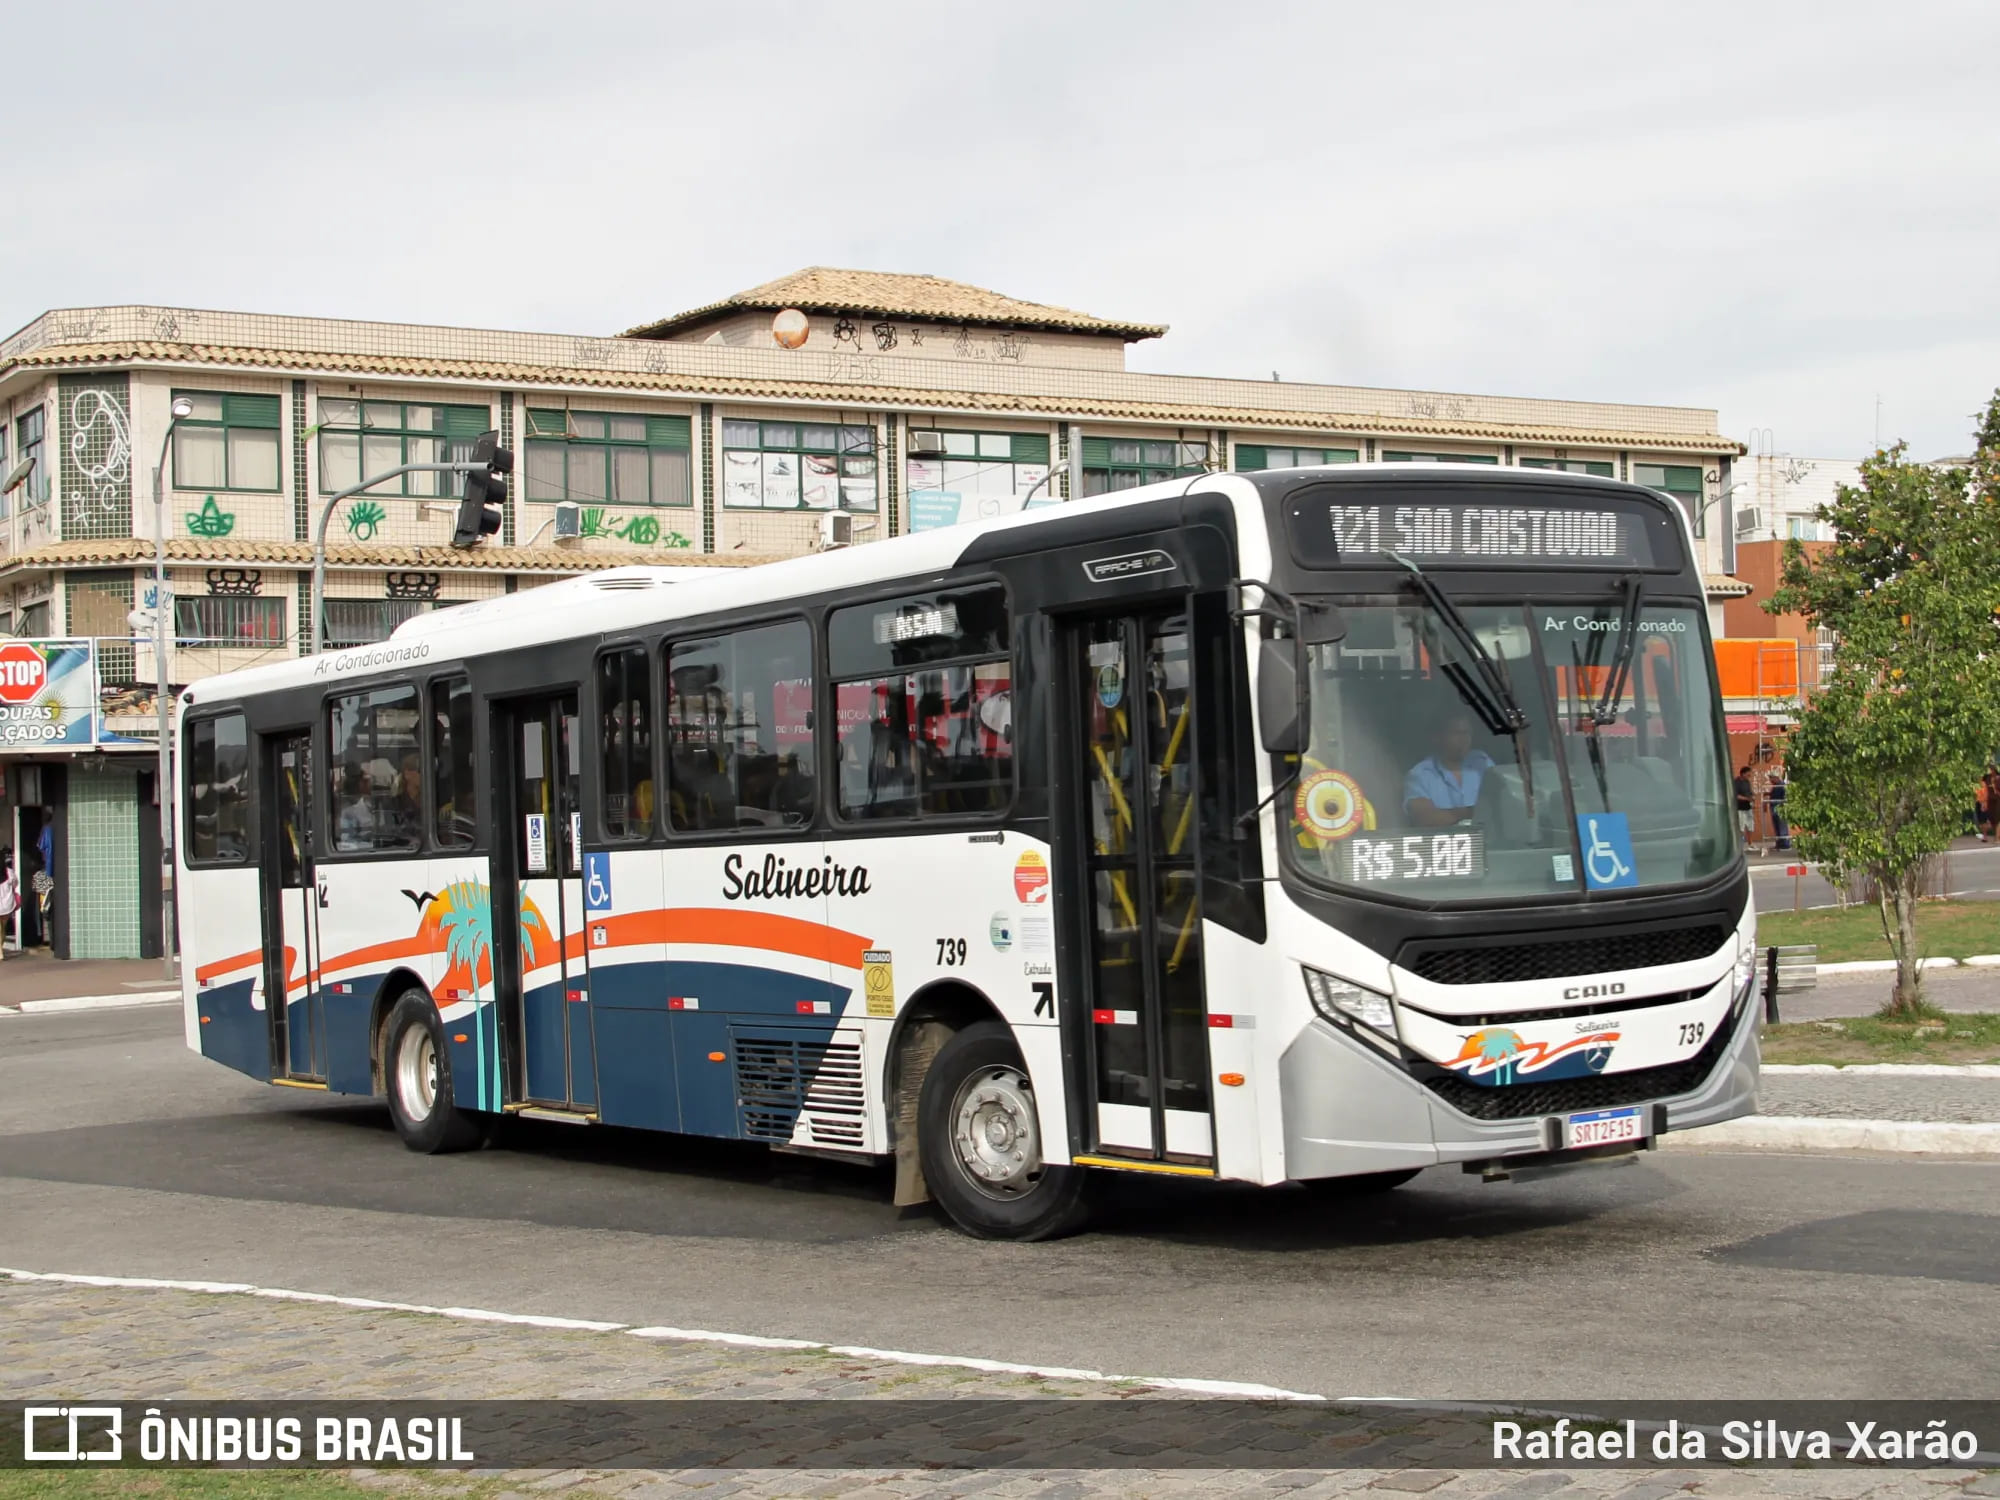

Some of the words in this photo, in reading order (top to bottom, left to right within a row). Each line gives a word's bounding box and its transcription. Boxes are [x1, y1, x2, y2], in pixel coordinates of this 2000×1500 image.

[1394, 507, 1452, 554] SAO
[1461, 508, 1617, 556] CRISTOVAO
[1544, 616, 1567, 632] Ar
[1573, 615, 1686, 632] Condonado
[314, 658, 332, 677] Ar
[335, 641, 430, 672] Condicionado
[1352, 839, 1394, 881] R$
[723, 853, 872, 900] Salineira
[936, 938, 967, 966] 739
[1563, 982, 1626, 1000] CAIO
[1678, 1022, 1705, 1046] 739
[1575, 1118, 1634, 1143] SRT2F15
